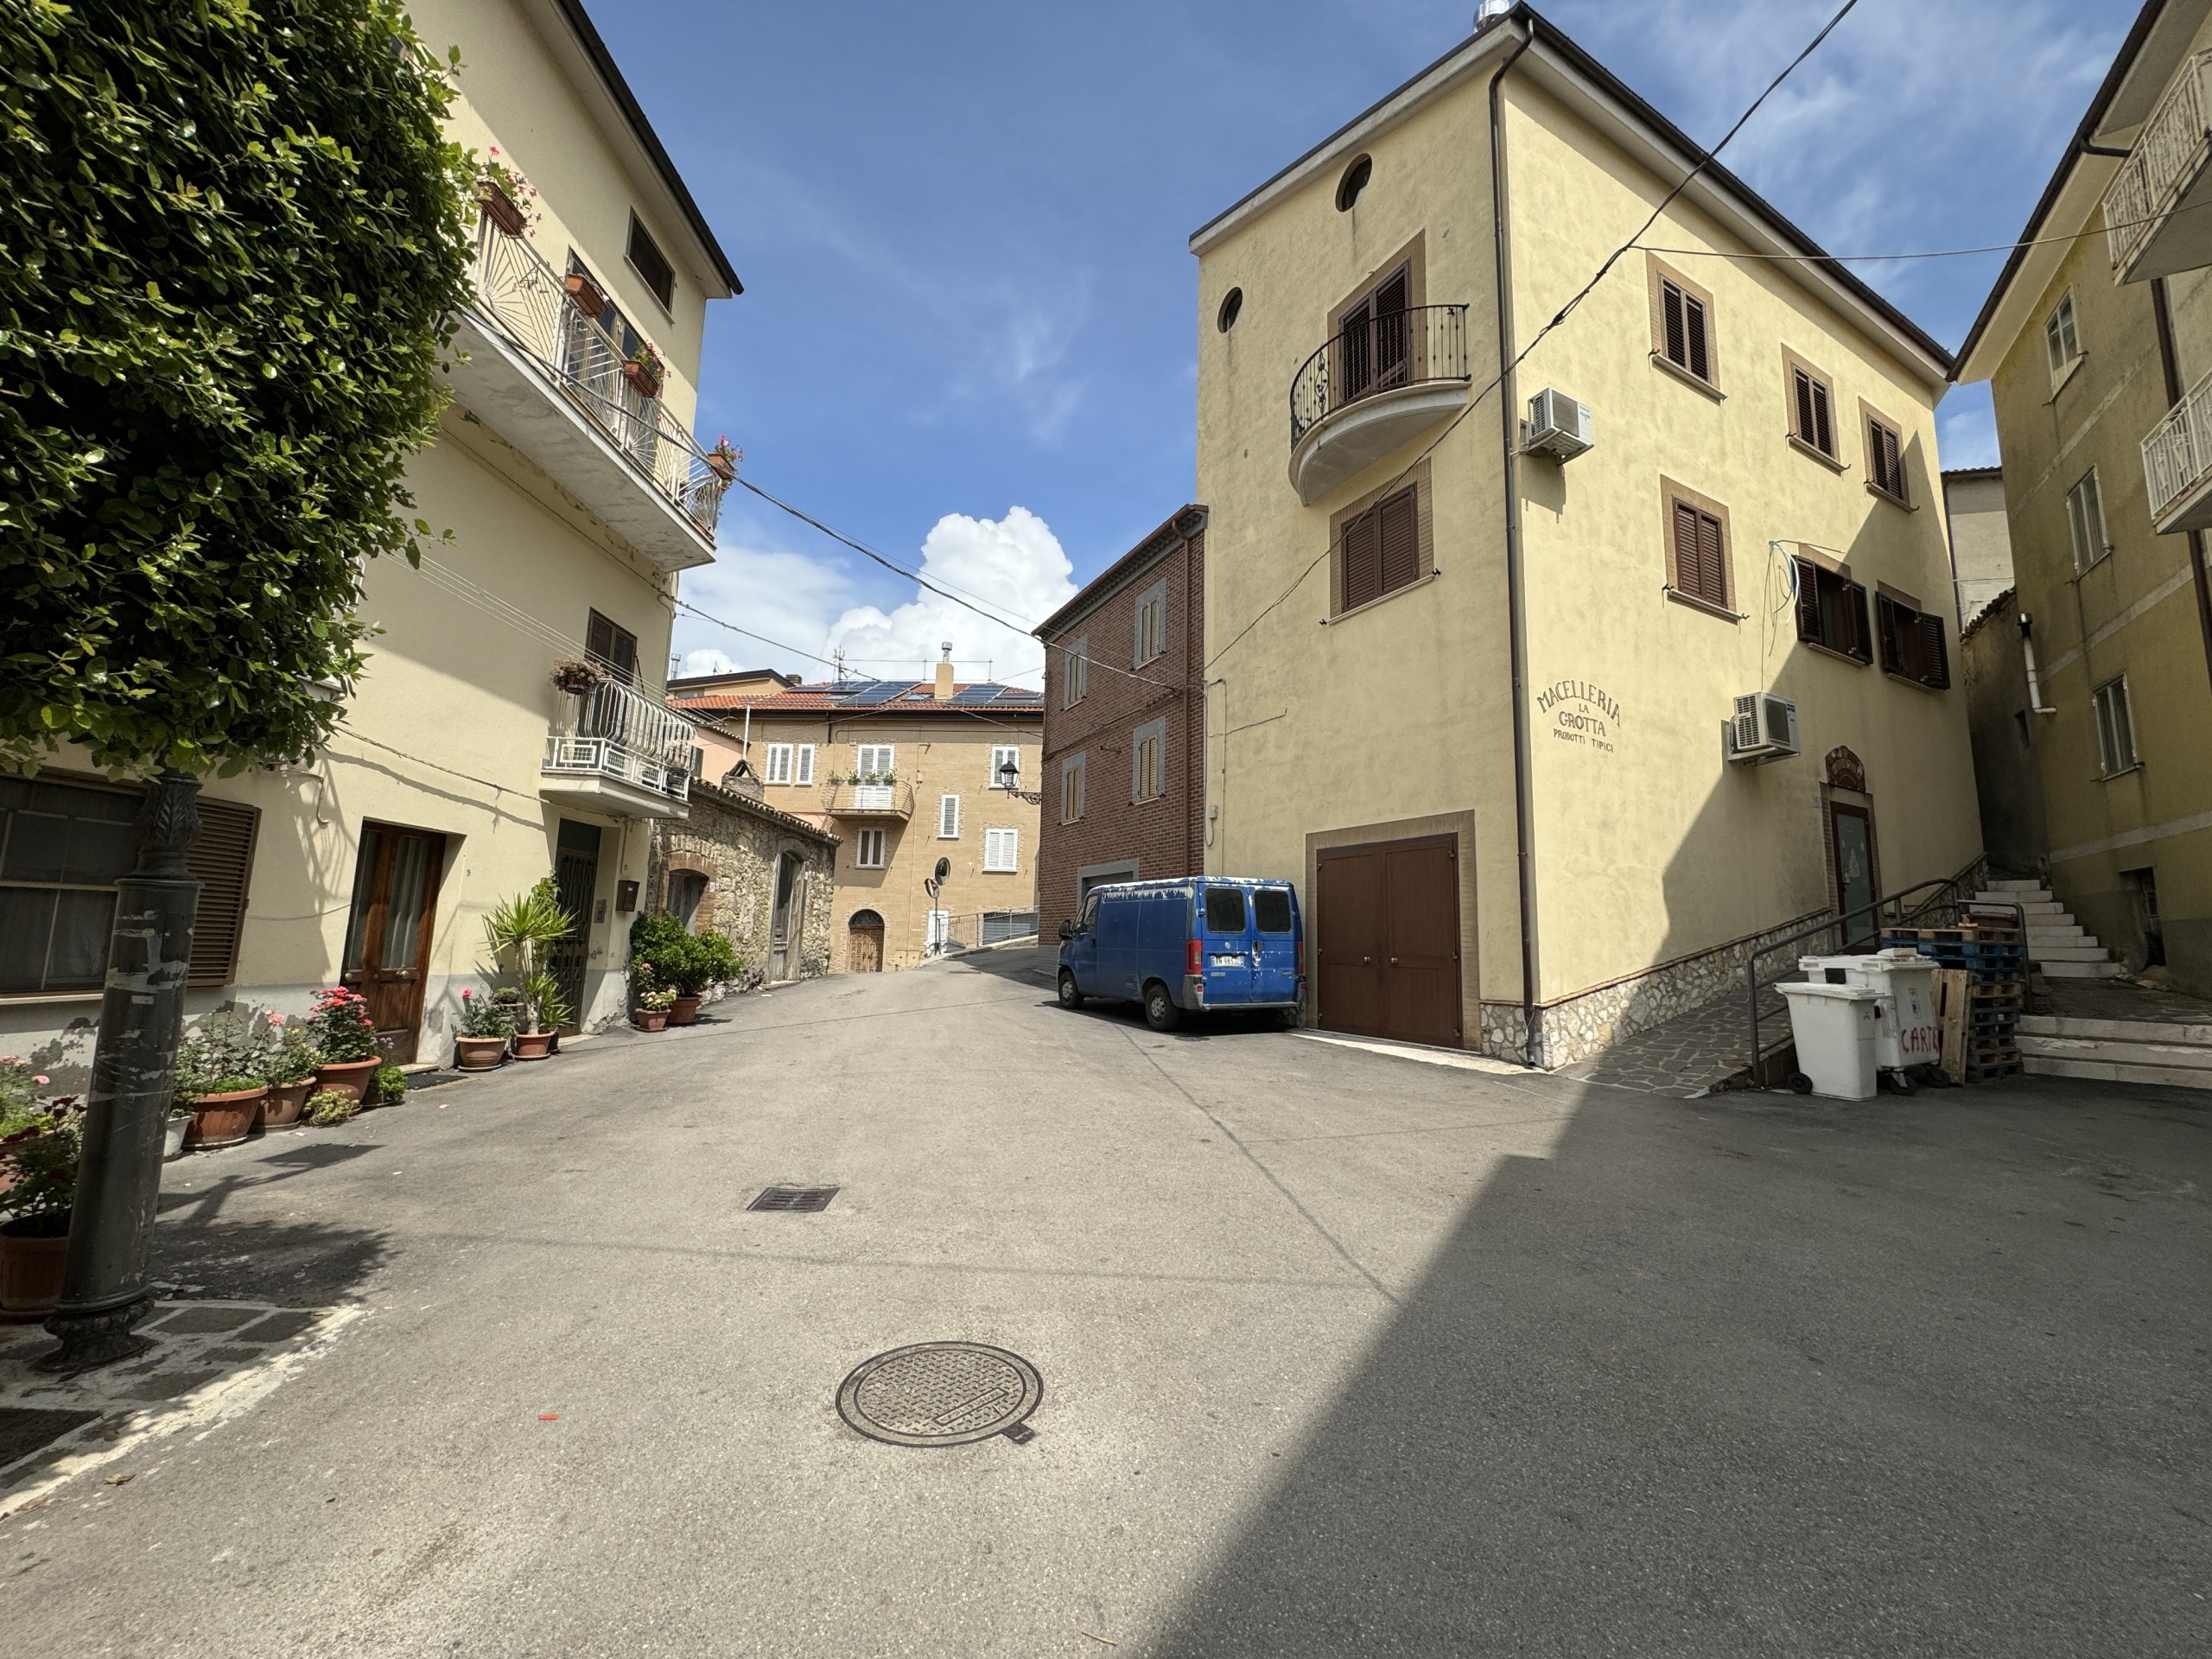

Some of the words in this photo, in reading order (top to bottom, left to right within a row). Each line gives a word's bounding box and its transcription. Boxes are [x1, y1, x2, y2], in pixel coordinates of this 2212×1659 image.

[1536, 680, 1620, 728] MACELLERIA
[1579, 703, 1590, 714] LA
[1559, 711, 1606, 736] GROTTA
[467, 868, 471, 877] 9
